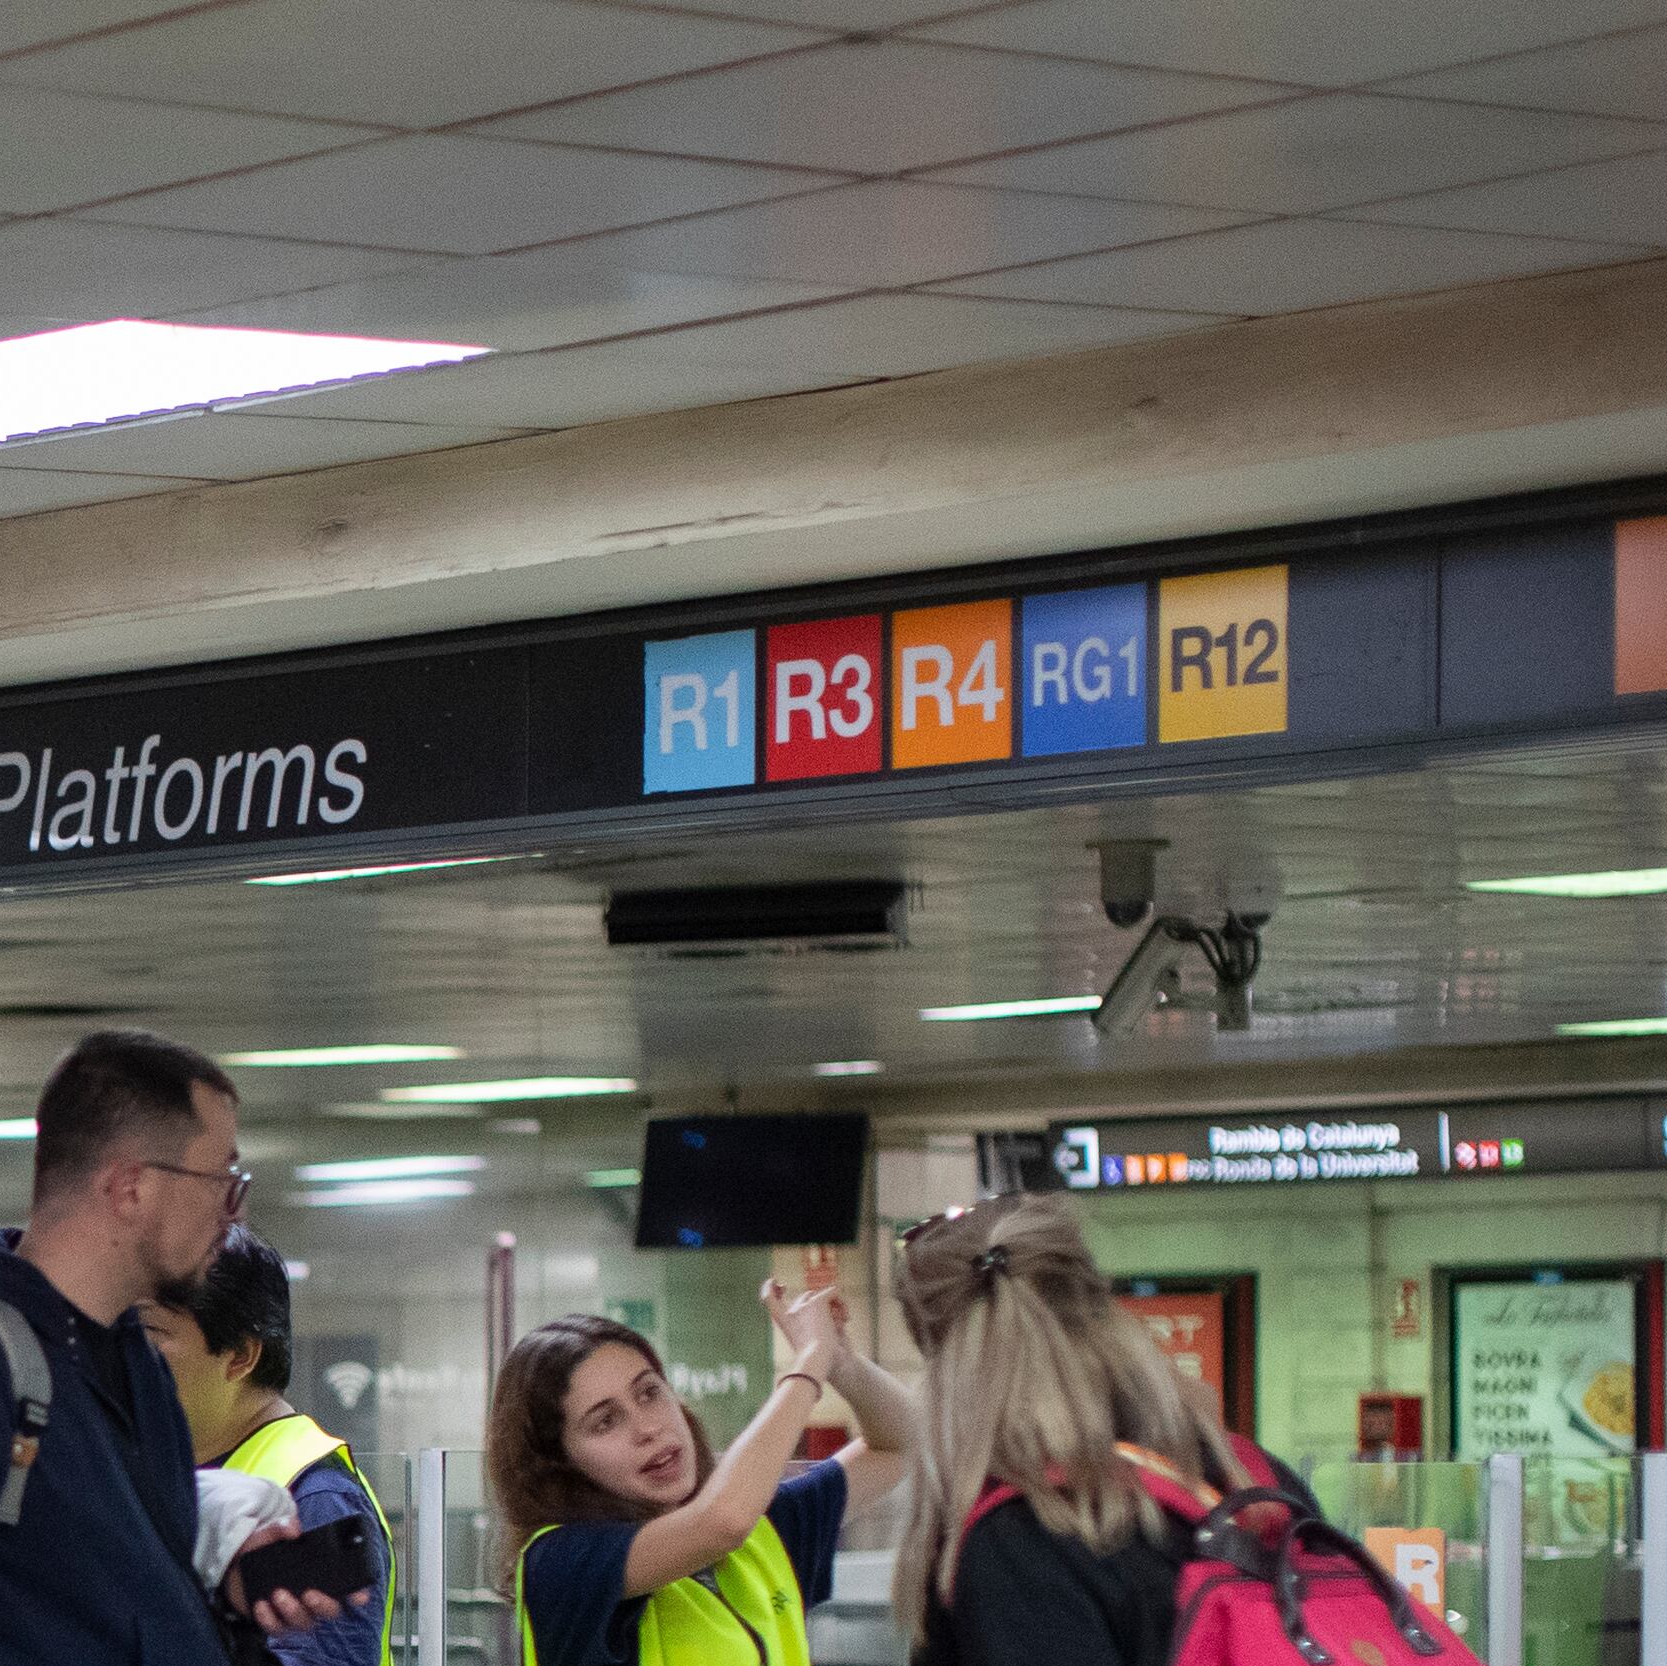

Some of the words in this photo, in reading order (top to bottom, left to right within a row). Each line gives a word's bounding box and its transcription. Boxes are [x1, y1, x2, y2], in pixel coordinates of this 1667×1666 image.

[659, 669, 739, 754] R1
[774, 653, 874, 744] R3
[900, 639, 1005, 731] R4
[1032, 636, 1138, 709] RG1
[1171, 618, 1280, 693] R12
[1395, 1543, 1440, 1604] R
